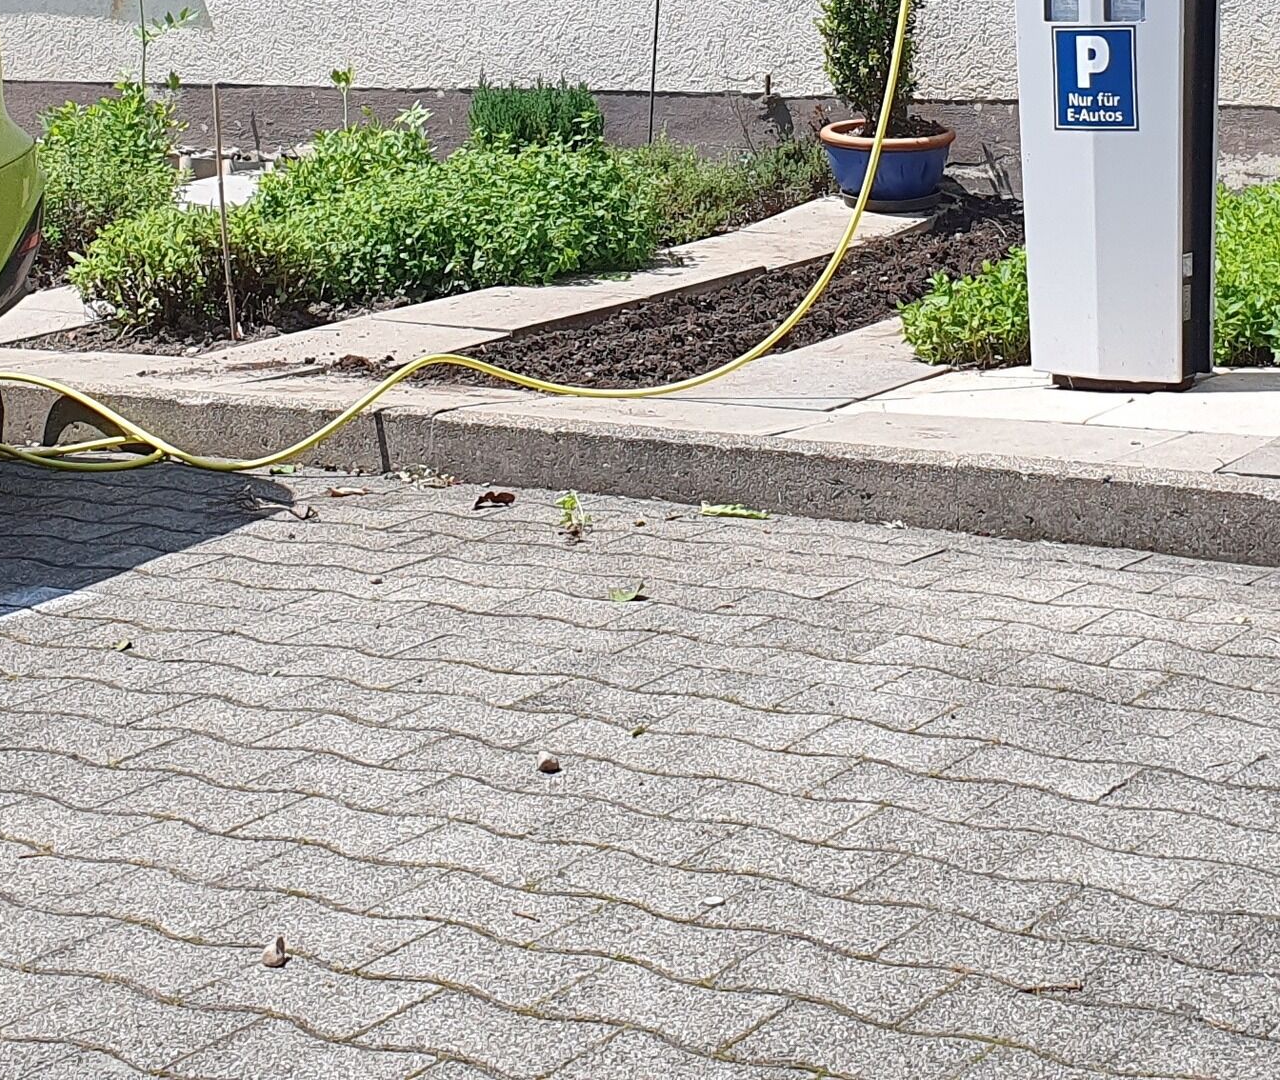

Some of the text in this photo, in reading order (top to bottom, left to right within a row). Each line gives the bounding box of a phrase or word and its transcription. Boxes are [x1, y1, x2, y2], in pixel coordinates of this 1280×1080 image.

[1075, 35, 1111, 89] P
[1068, 92, 1121, 107] Nur für
[1066, 108, 1124, 122] E-Autos
